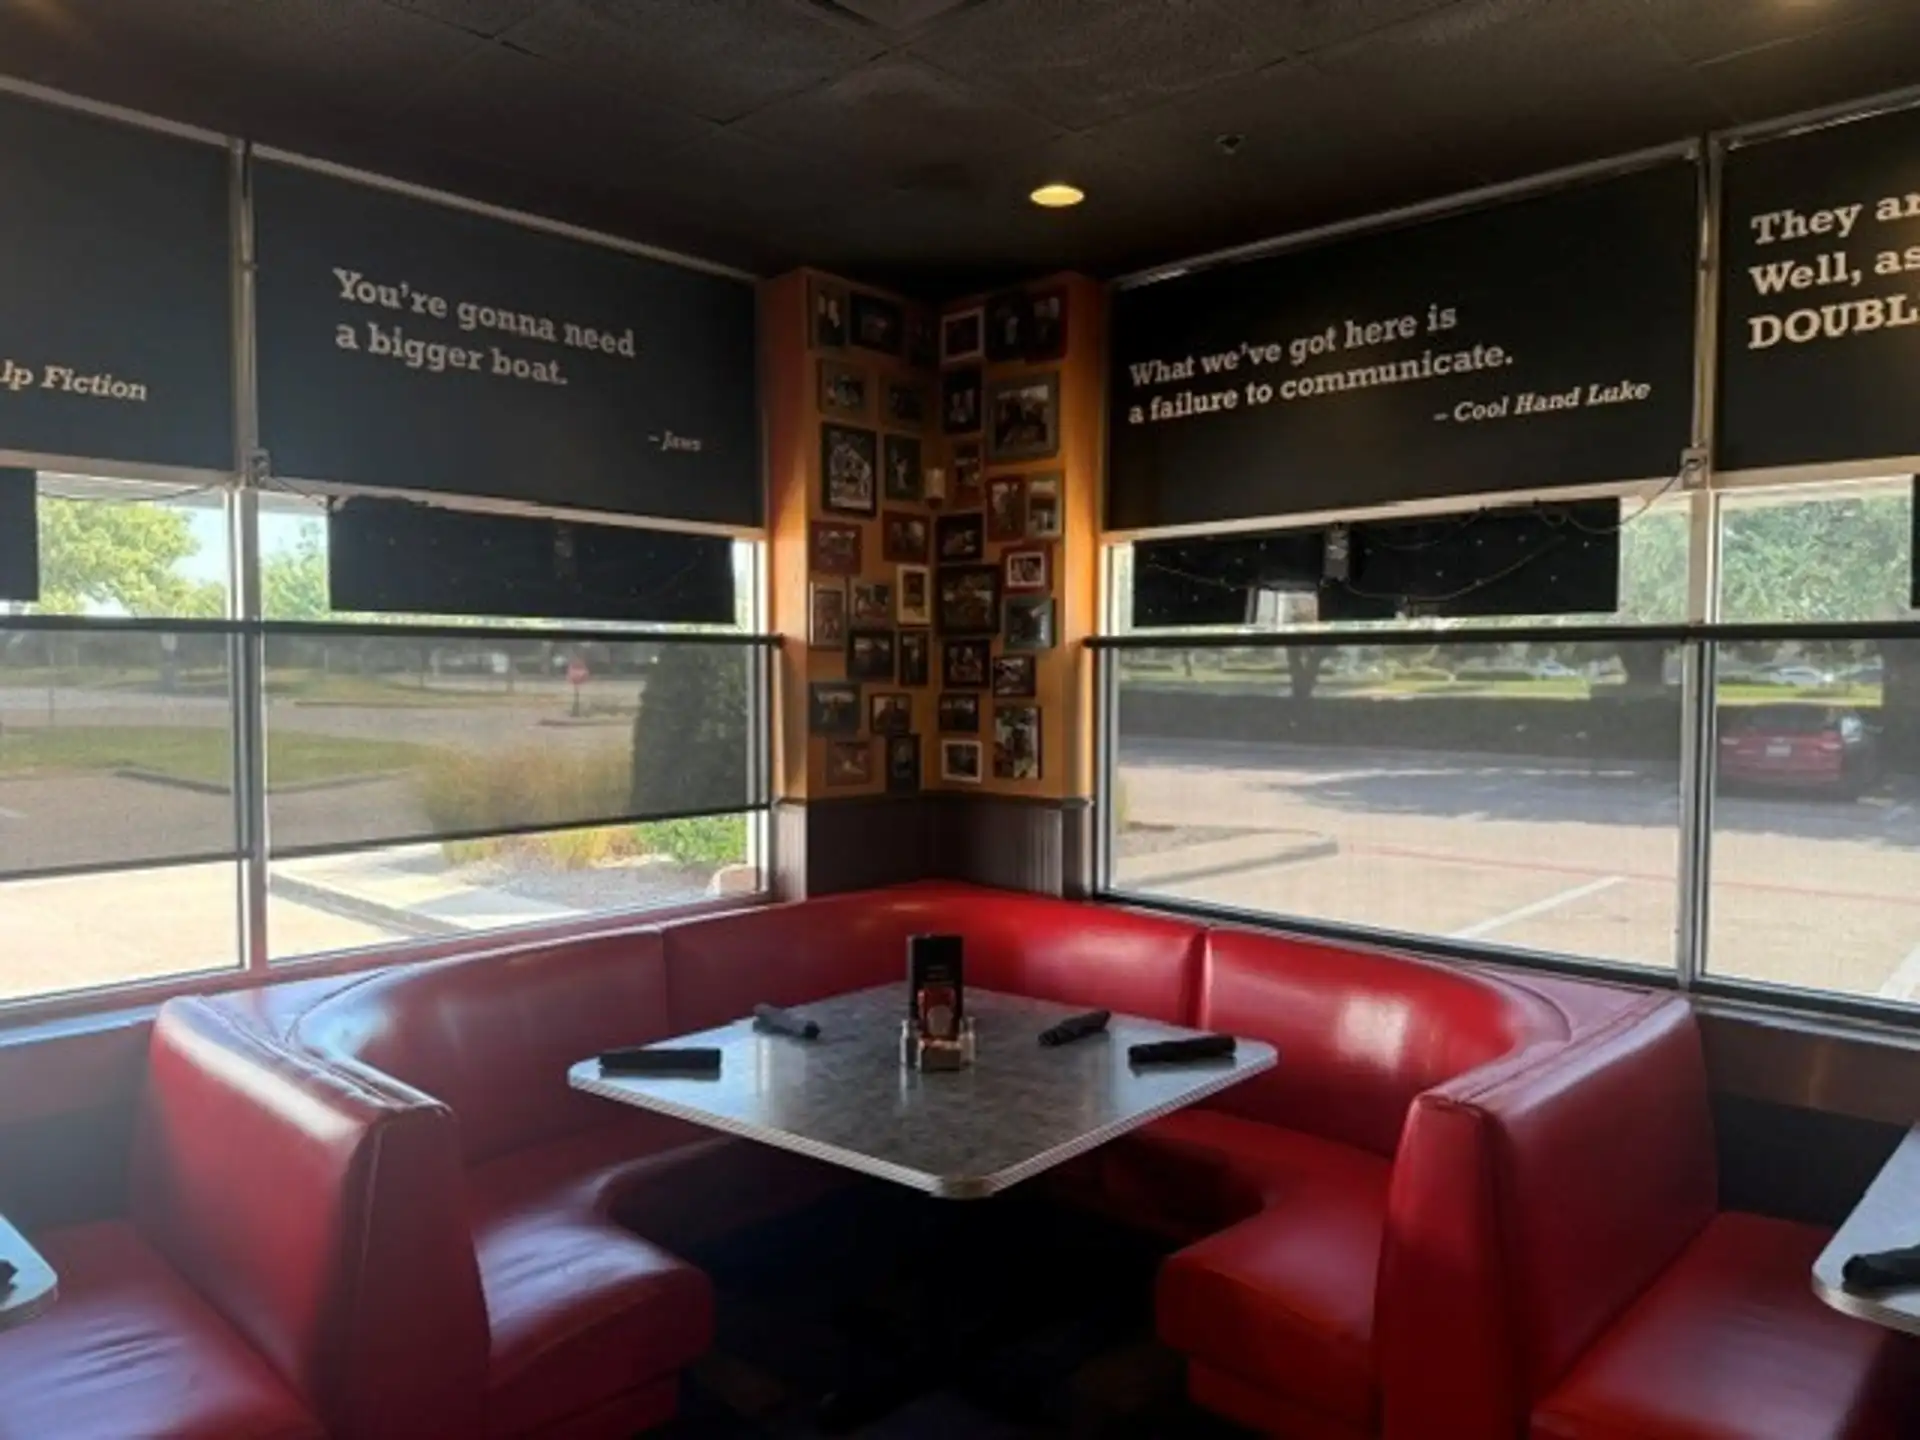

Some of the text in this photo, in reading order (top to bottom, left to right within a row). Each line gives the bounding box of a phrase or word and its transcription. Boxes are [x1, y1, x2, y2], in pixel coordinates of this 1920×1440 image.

[1751, 203, 1863, 245] They
[1748, 246, 1920, 295] Well, as
[333, 267, 636, 358] You're gonna need
[335, 322, 569, 385] a bigger boat.
[1129, 303, 1457, 387] What we've got here is
[40, 364, 148, 401] Fiction
[1128, 343, 1514, 424] a failure to communicate.
[1454, 396, 1510, 421] Cool
[1514, 386, 1581, 415] Hand
[1586, 380, 1651, 406] Luke
[660, 430, 702, 452] Jaws
